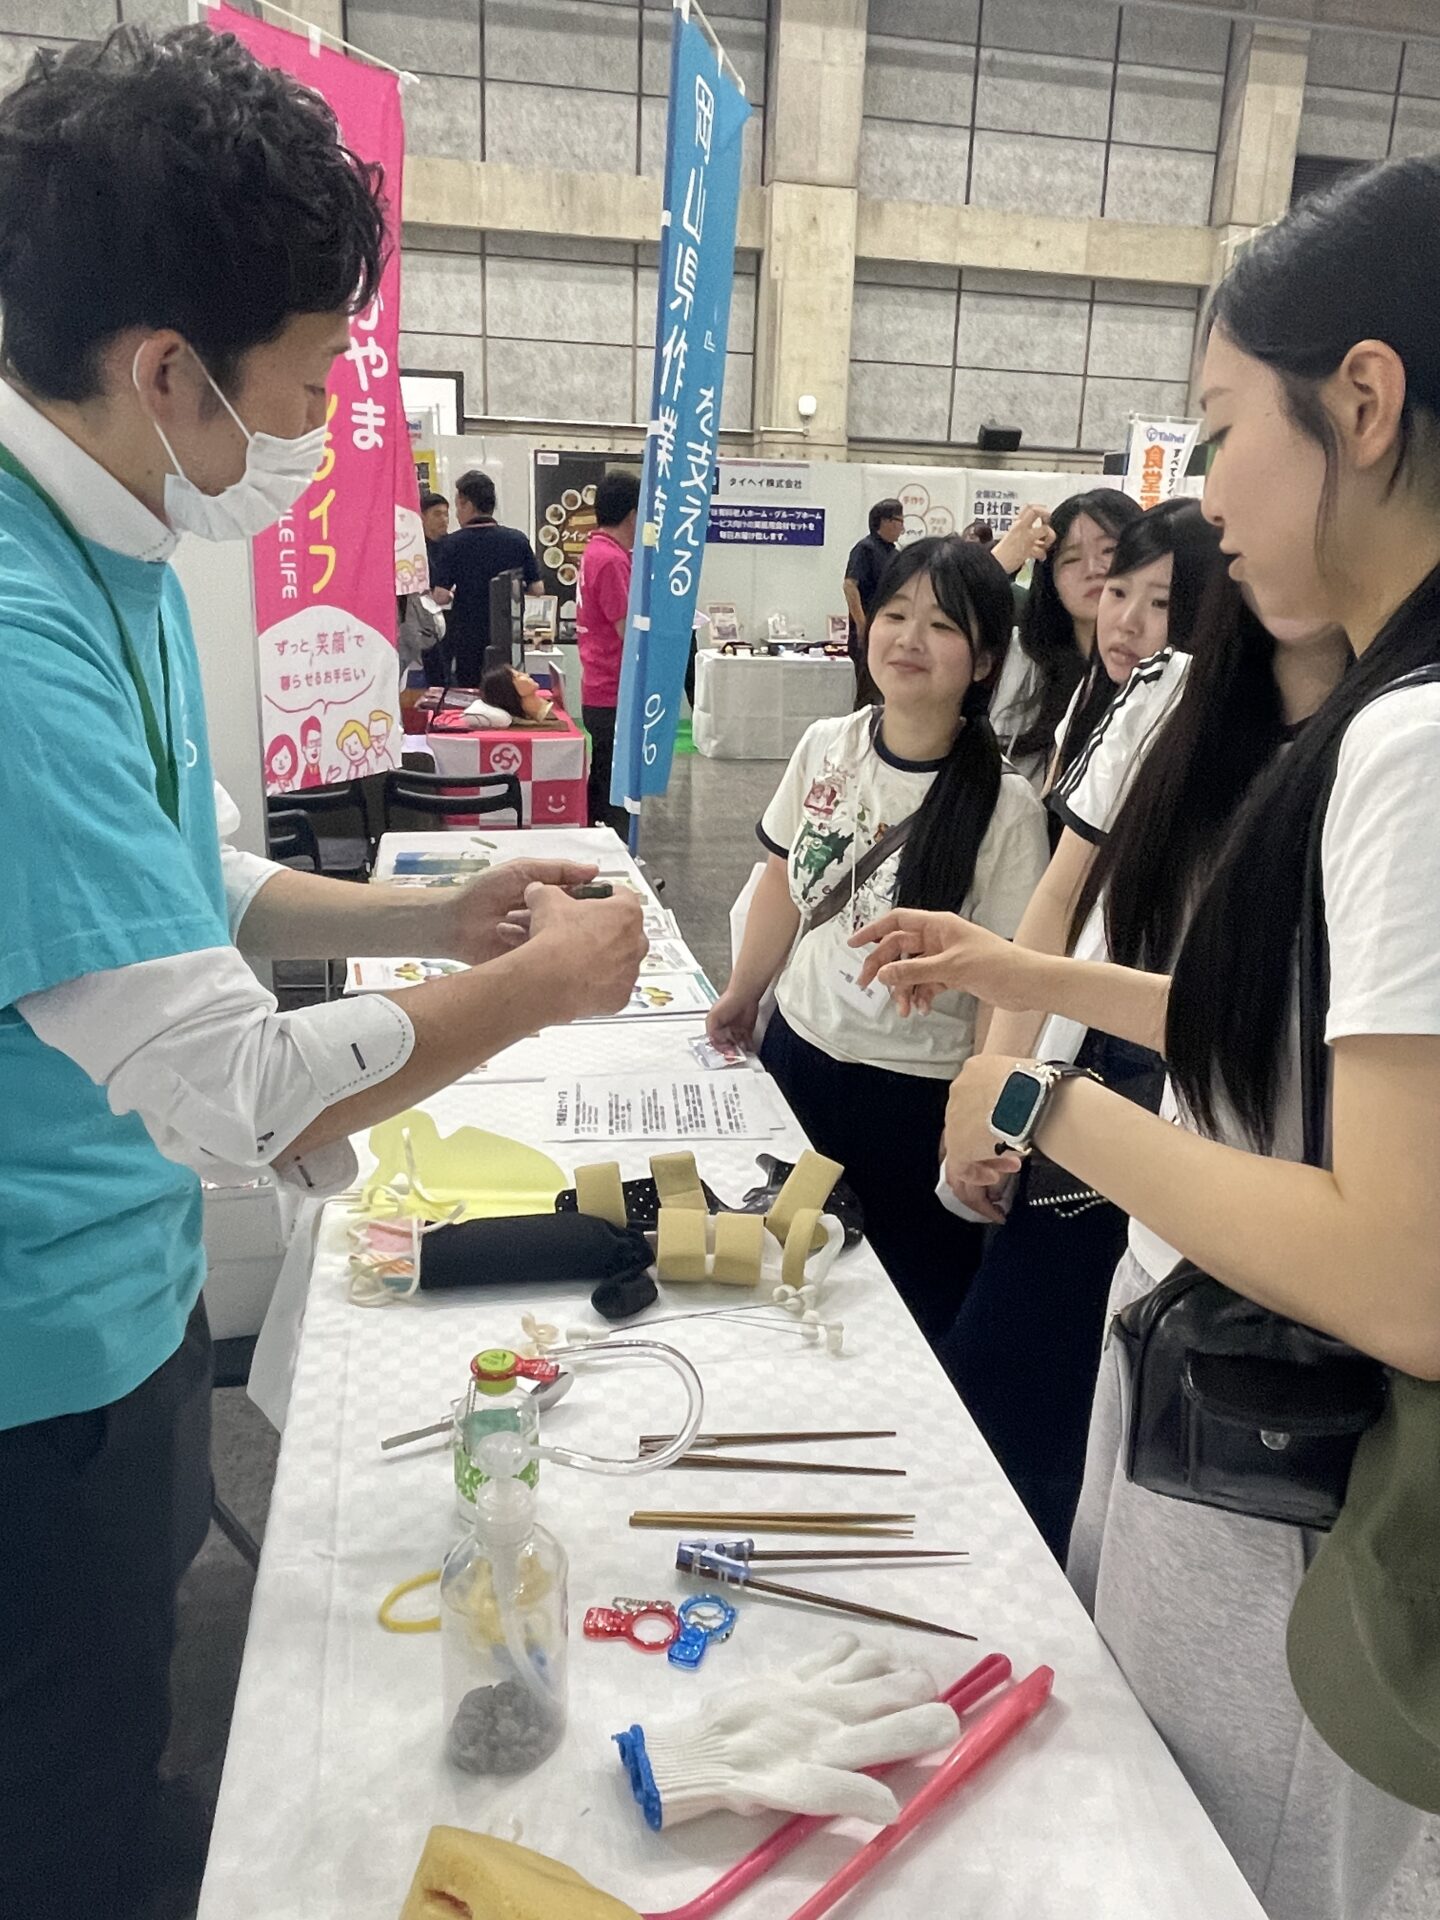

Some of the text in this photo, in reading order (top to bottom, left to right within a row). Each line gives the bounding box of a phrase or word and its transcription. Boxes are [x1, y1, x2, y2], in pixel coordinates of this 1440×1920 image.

[729, 477, 803, 490] タイヘイ株式会社
[279, 549, 298, 600] LIFE
